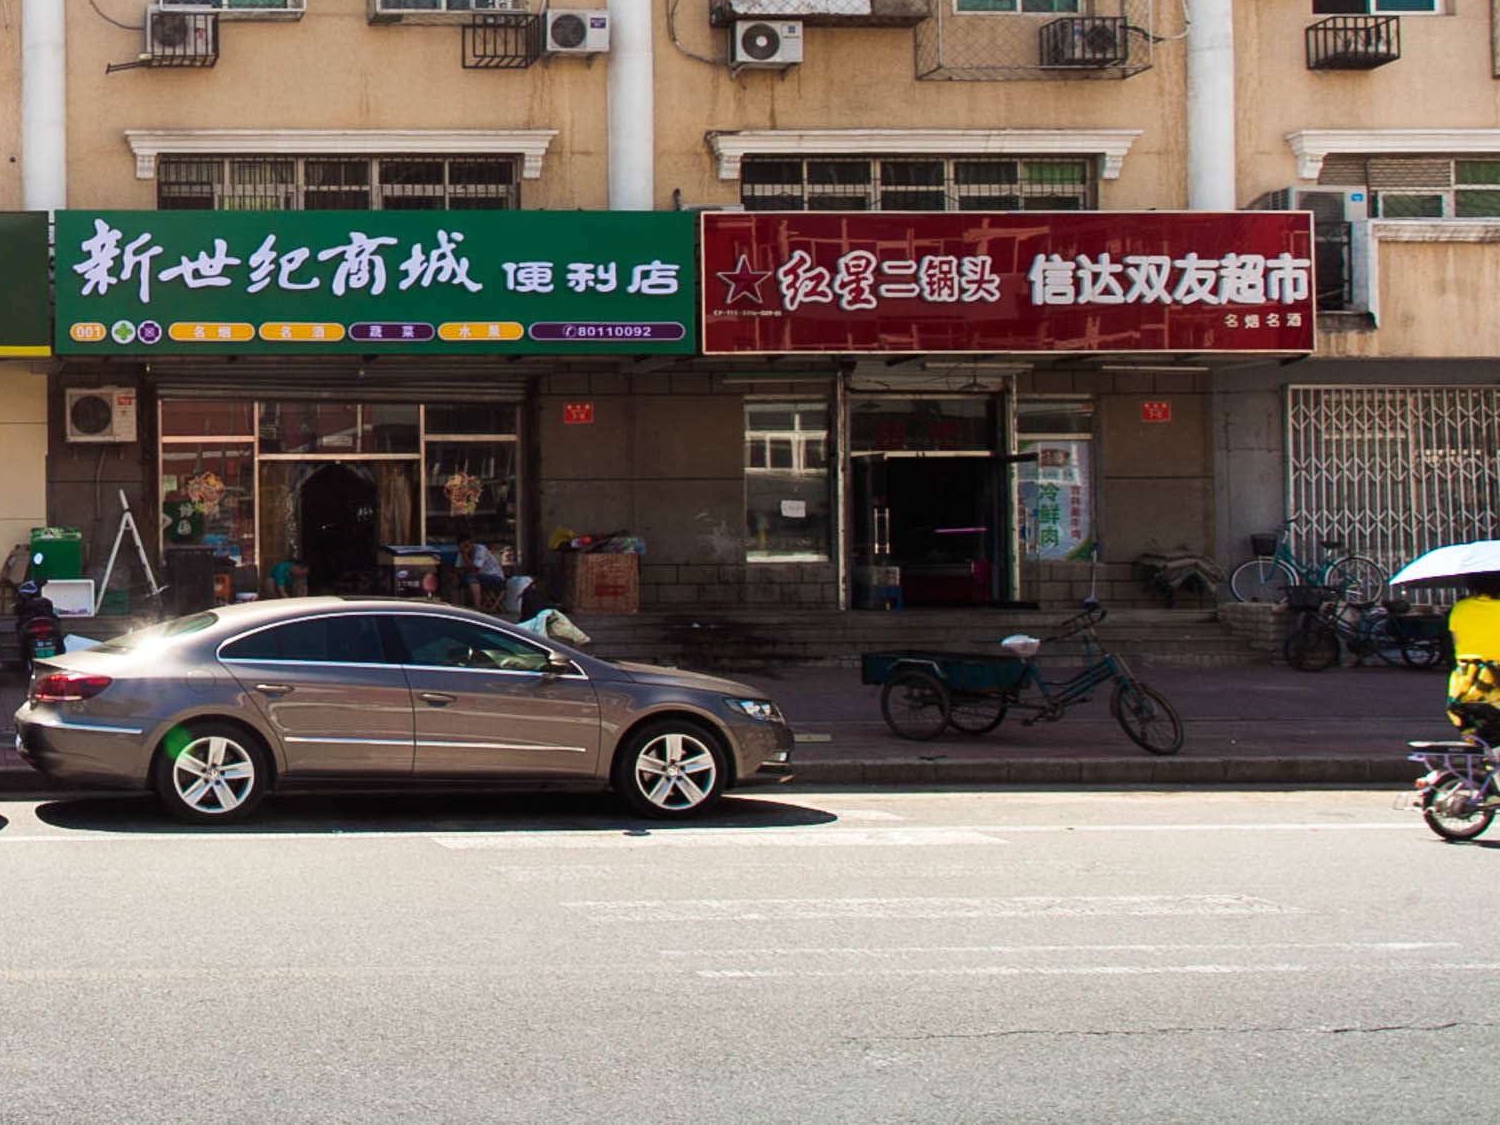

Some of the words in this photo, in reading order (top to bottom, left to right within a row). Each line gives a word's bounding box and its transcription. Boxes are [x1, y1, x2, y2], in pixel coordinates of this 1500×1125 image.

[72, 218, 483, 304] 新世纪商城
[501, 260, 681, 295] 便利店
[777, 250, 1001, 310] 红星二锅头
[1029, 252, 1311, 306] 信达双友超市
[577, 326, 652, 337] 80110092
